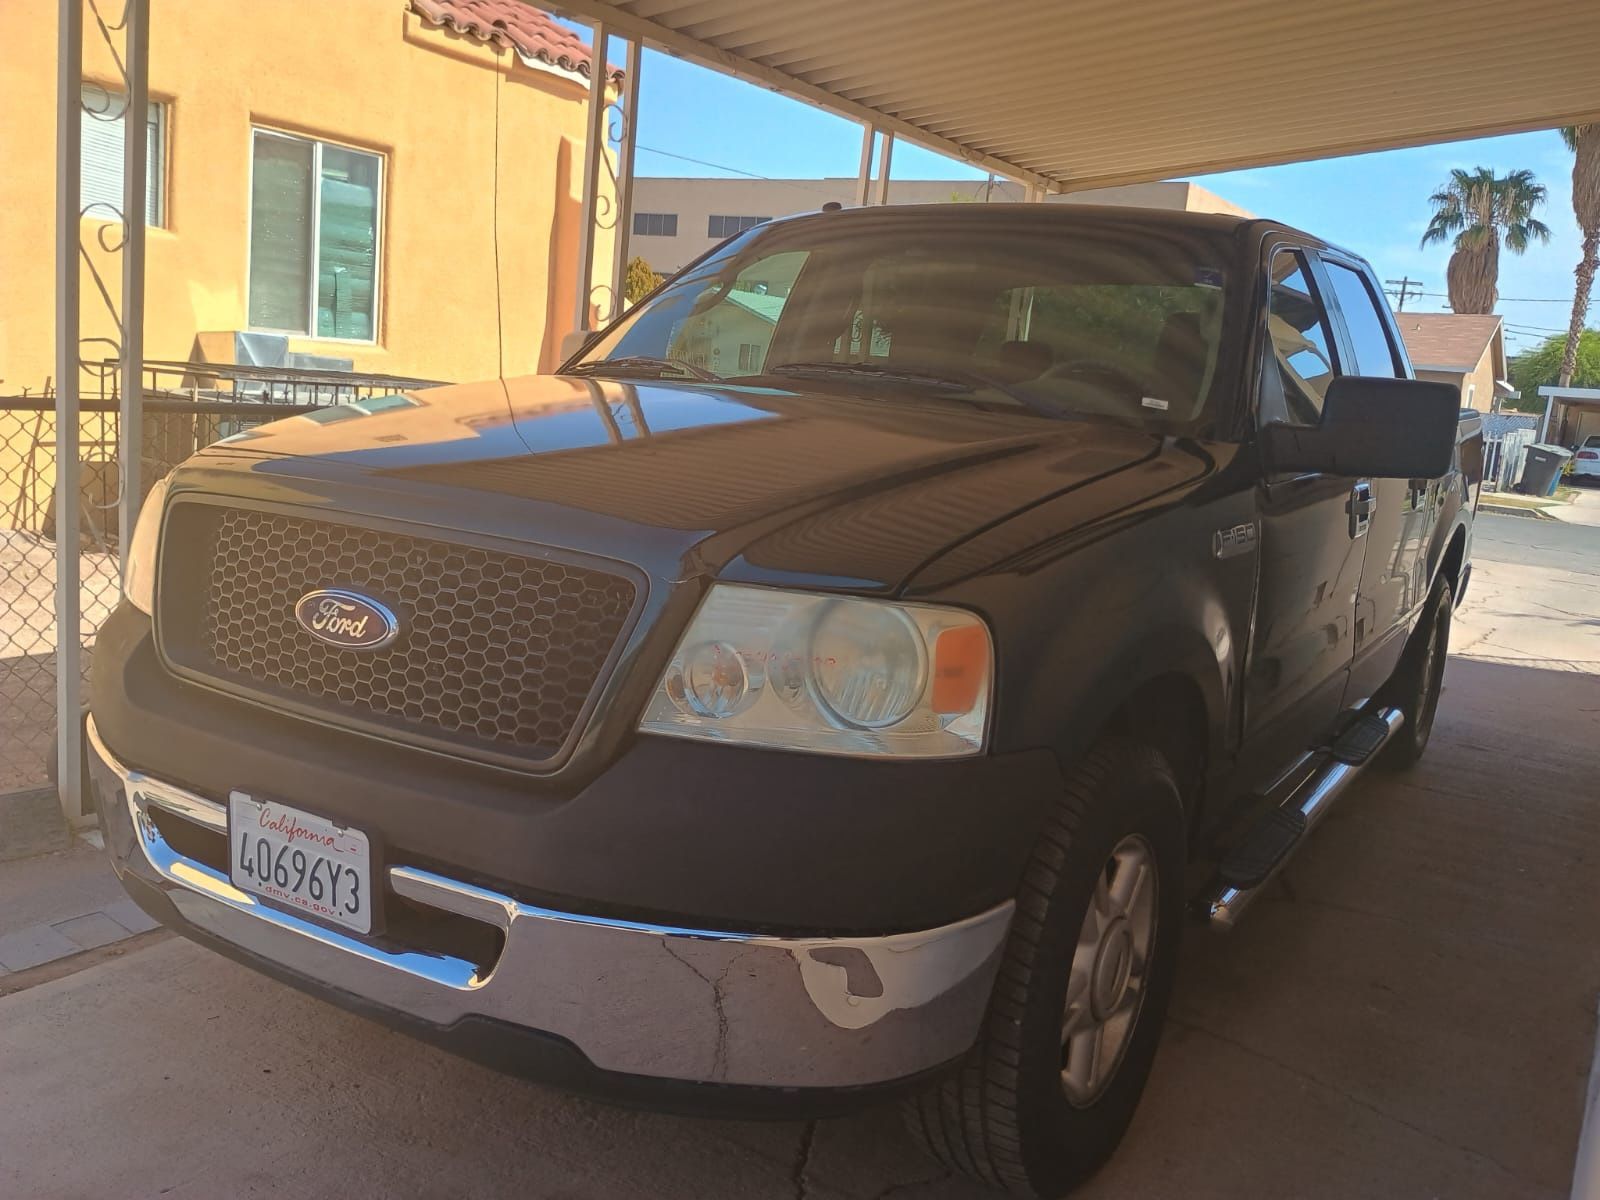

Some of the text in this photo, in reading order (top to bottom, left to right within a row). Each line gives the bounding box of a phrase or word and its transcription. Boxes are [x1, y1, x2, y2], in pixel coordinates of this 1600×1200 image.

[312, 598, 369, 638] Ford
[259, 807, 344, 852] California
[239, 831, 360, 914] 40696Y3
[265, 885, 336, 916] dmv.ca.gov
